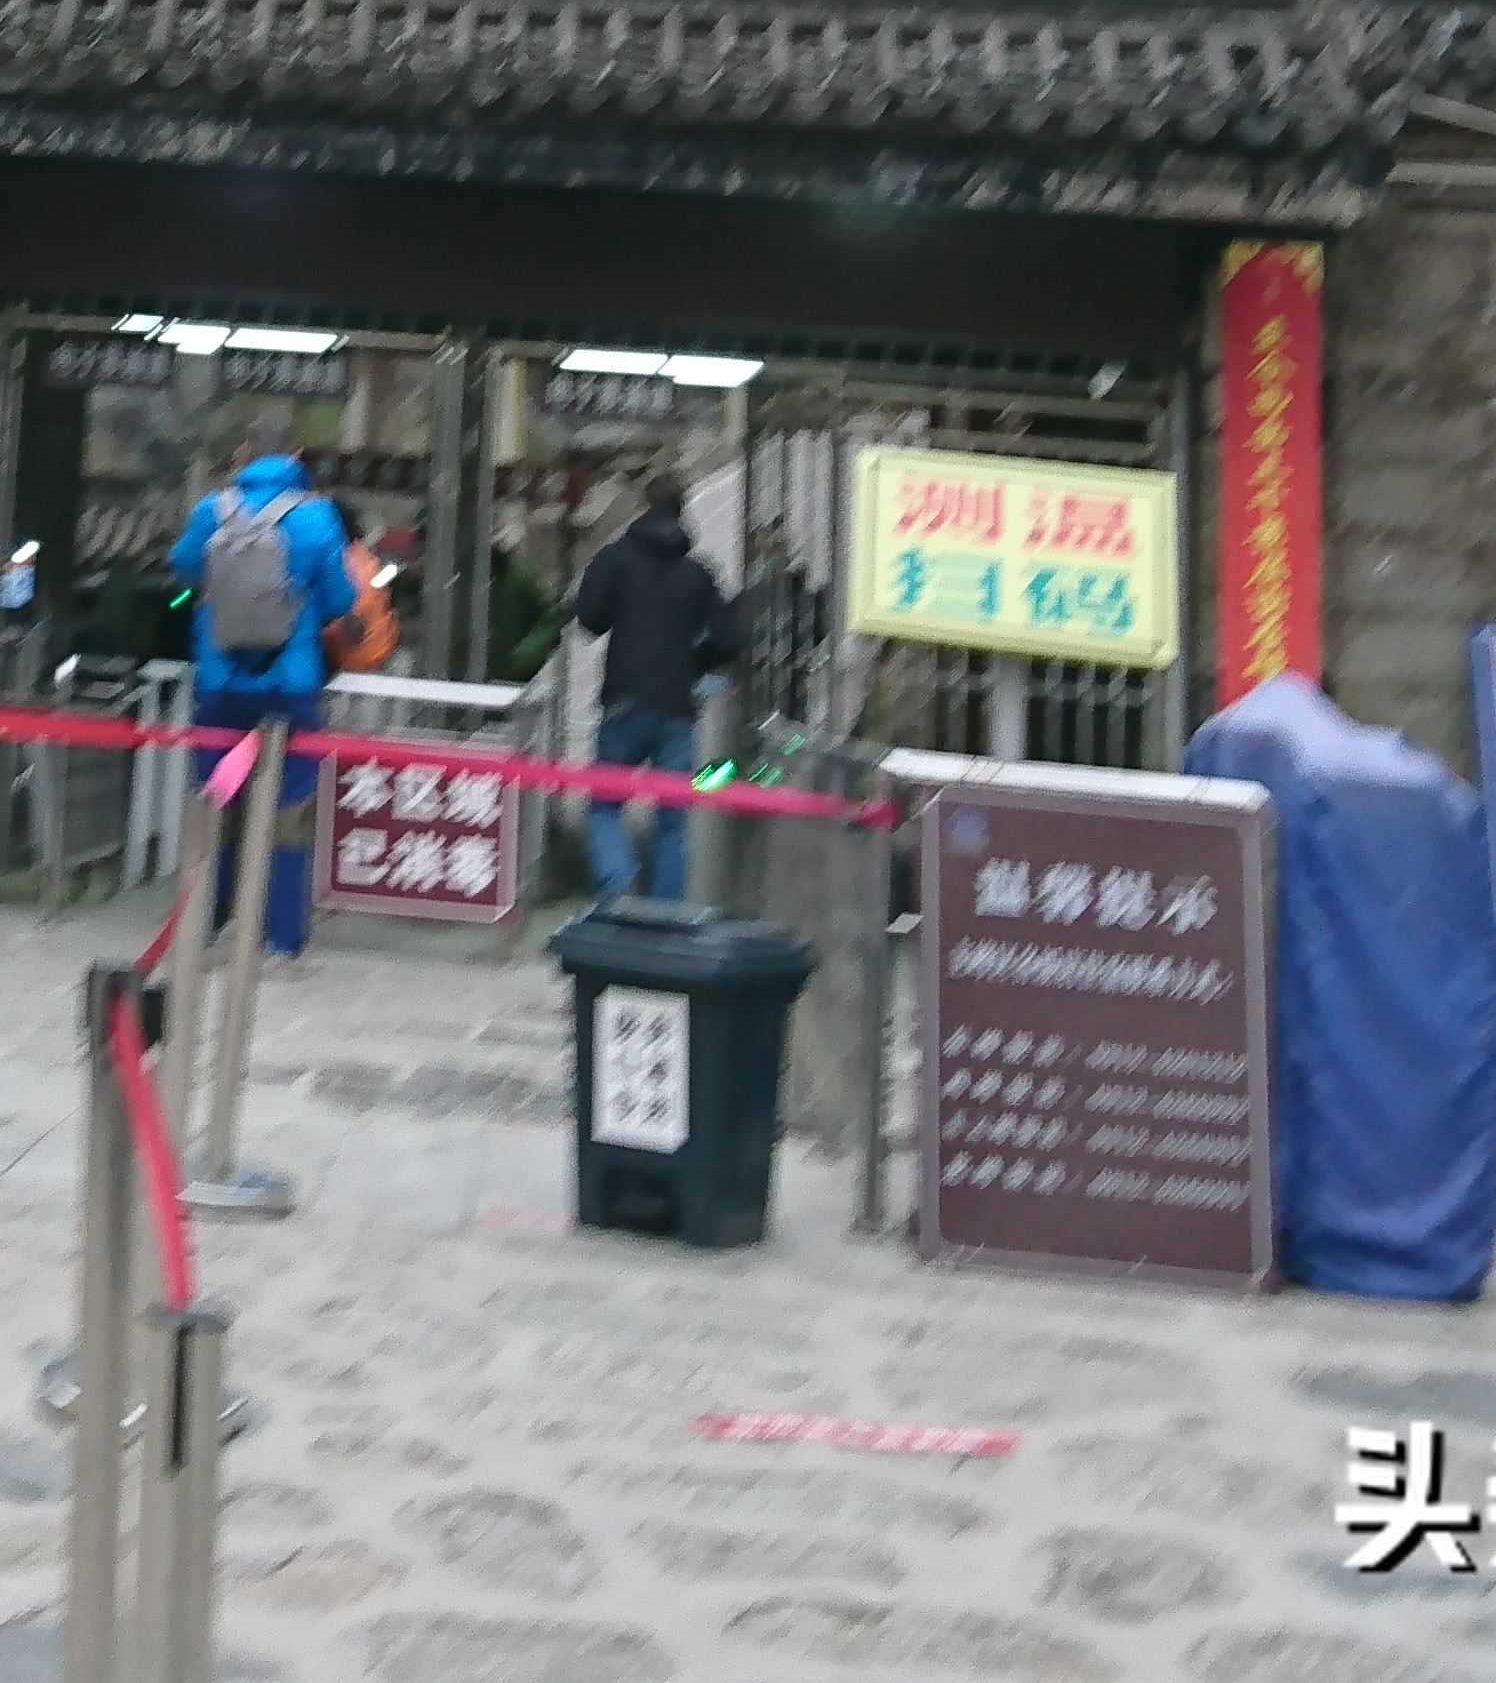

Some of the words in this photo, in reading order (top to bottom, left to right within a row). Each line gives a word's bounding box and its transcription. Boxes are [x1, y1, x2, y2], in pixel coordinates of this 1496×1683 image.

[889, 545, 1138, 641] 扫码
[336, 755, 504, 829] 本区域
[336, 826, 500, 898] 已消毒
